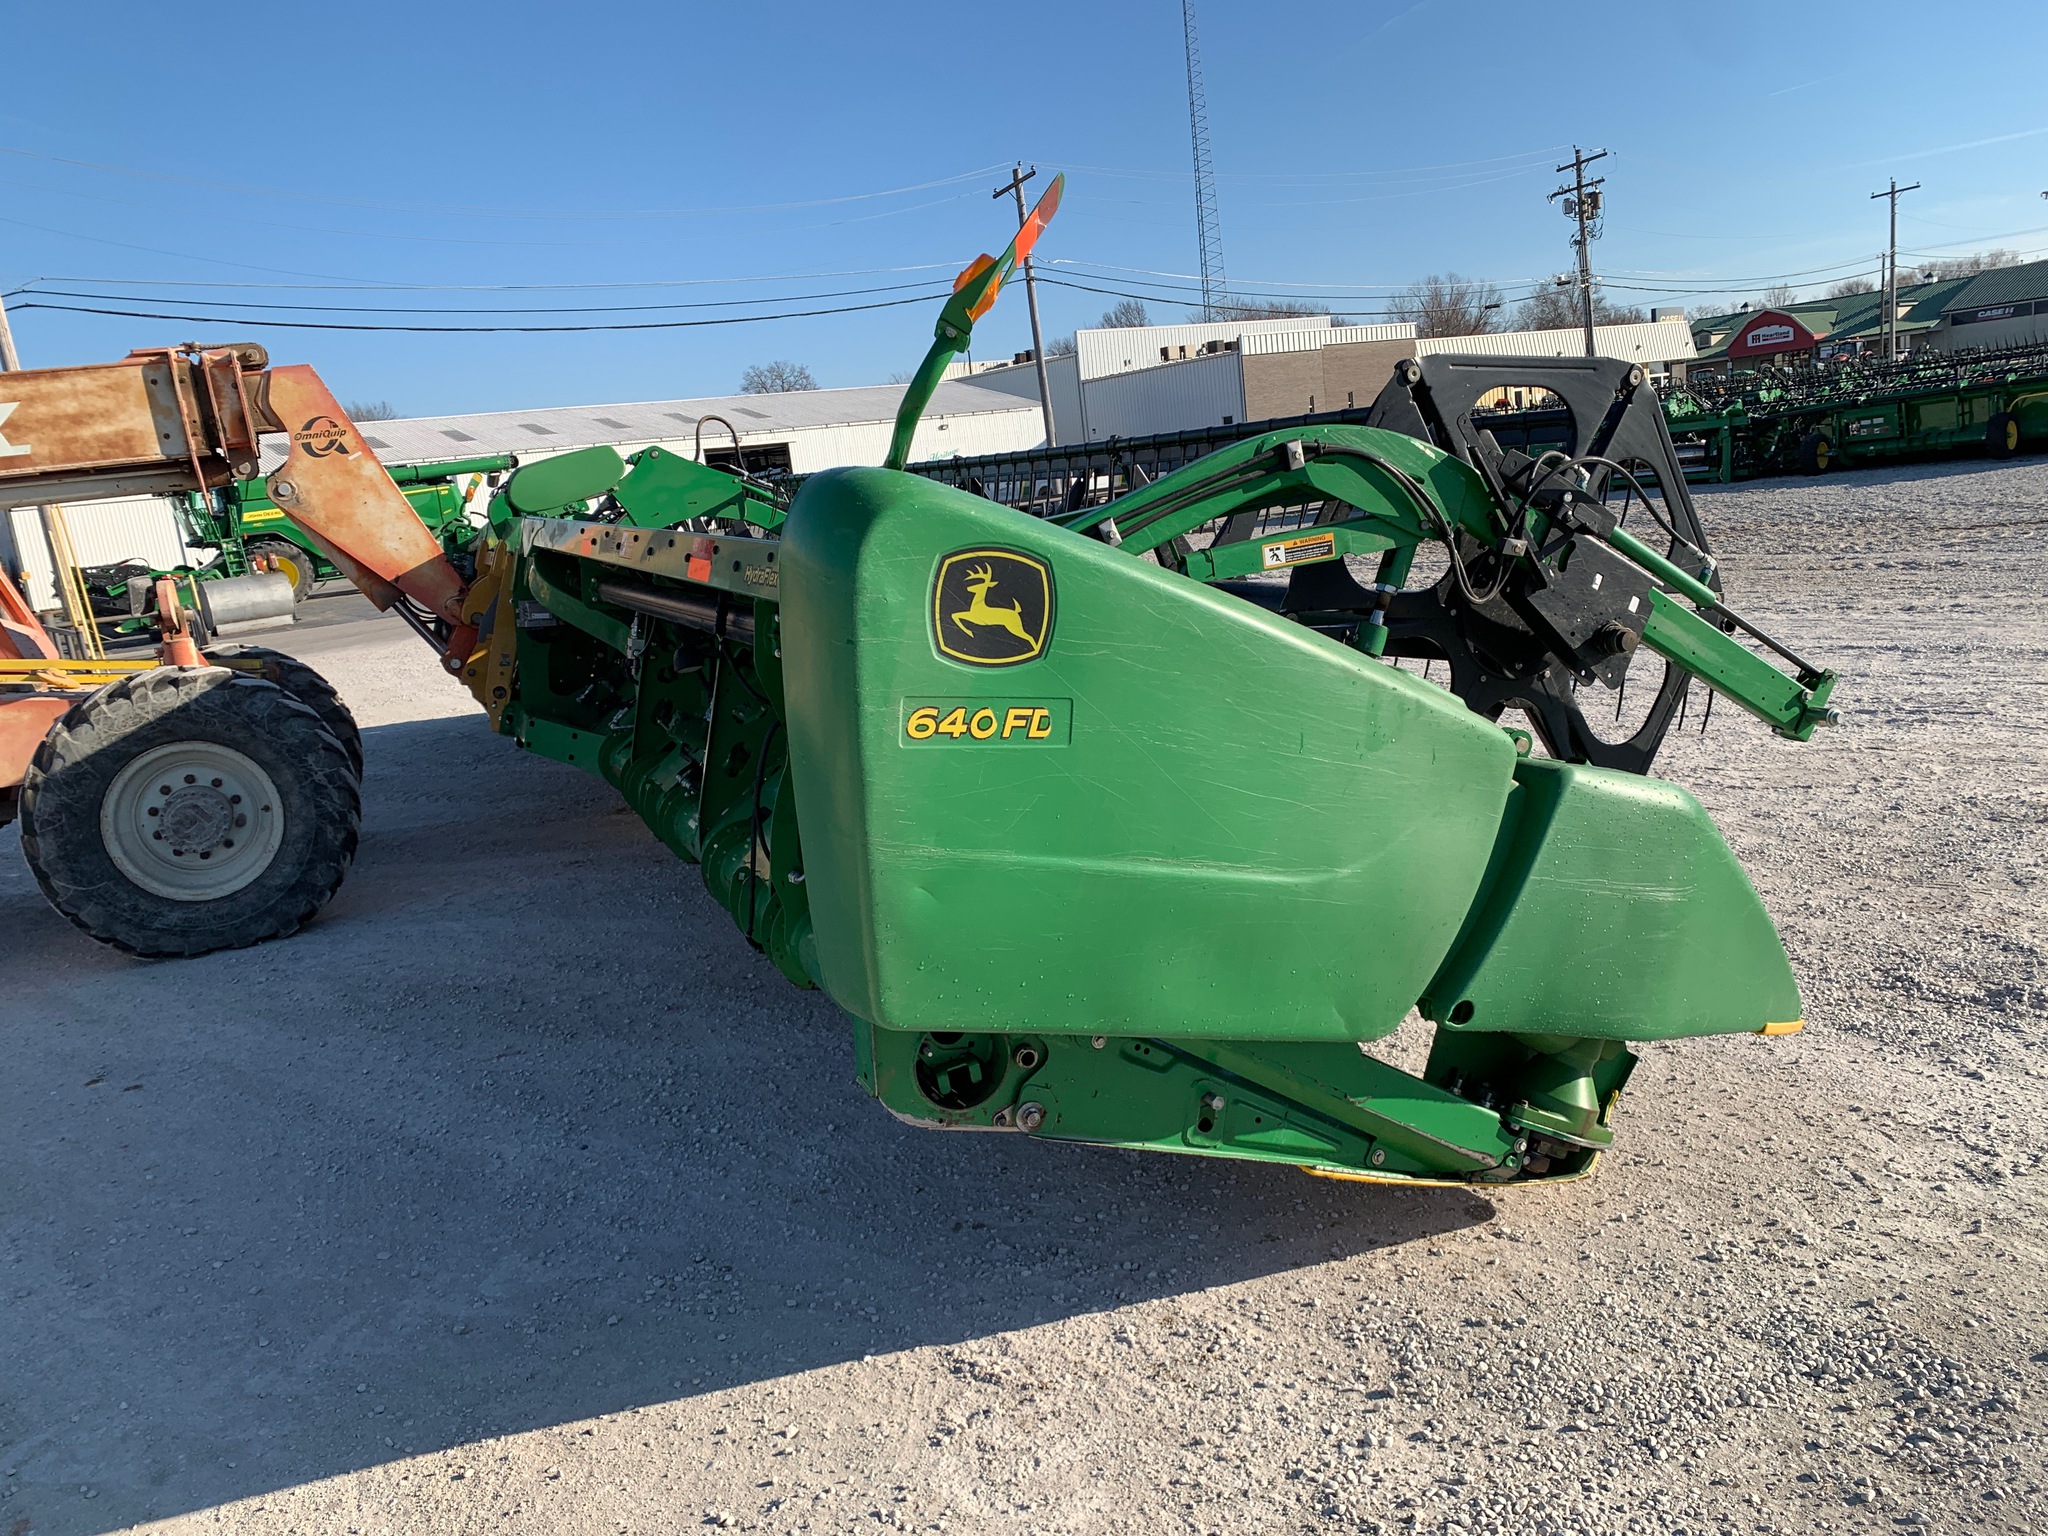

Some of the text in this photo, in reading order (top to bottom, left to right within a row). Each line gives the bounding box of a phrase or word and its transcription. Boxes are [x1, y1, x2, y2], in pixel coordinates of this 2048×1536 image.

[1977, 308, 2004, 317] CASE
[1761, 330, 1790, 338] Heartland
[294, 428, 347, 442] OmniQuip
[1299, 535, 1326, 544] WARNING
[743, 564, 779, 587] HydraFlex
